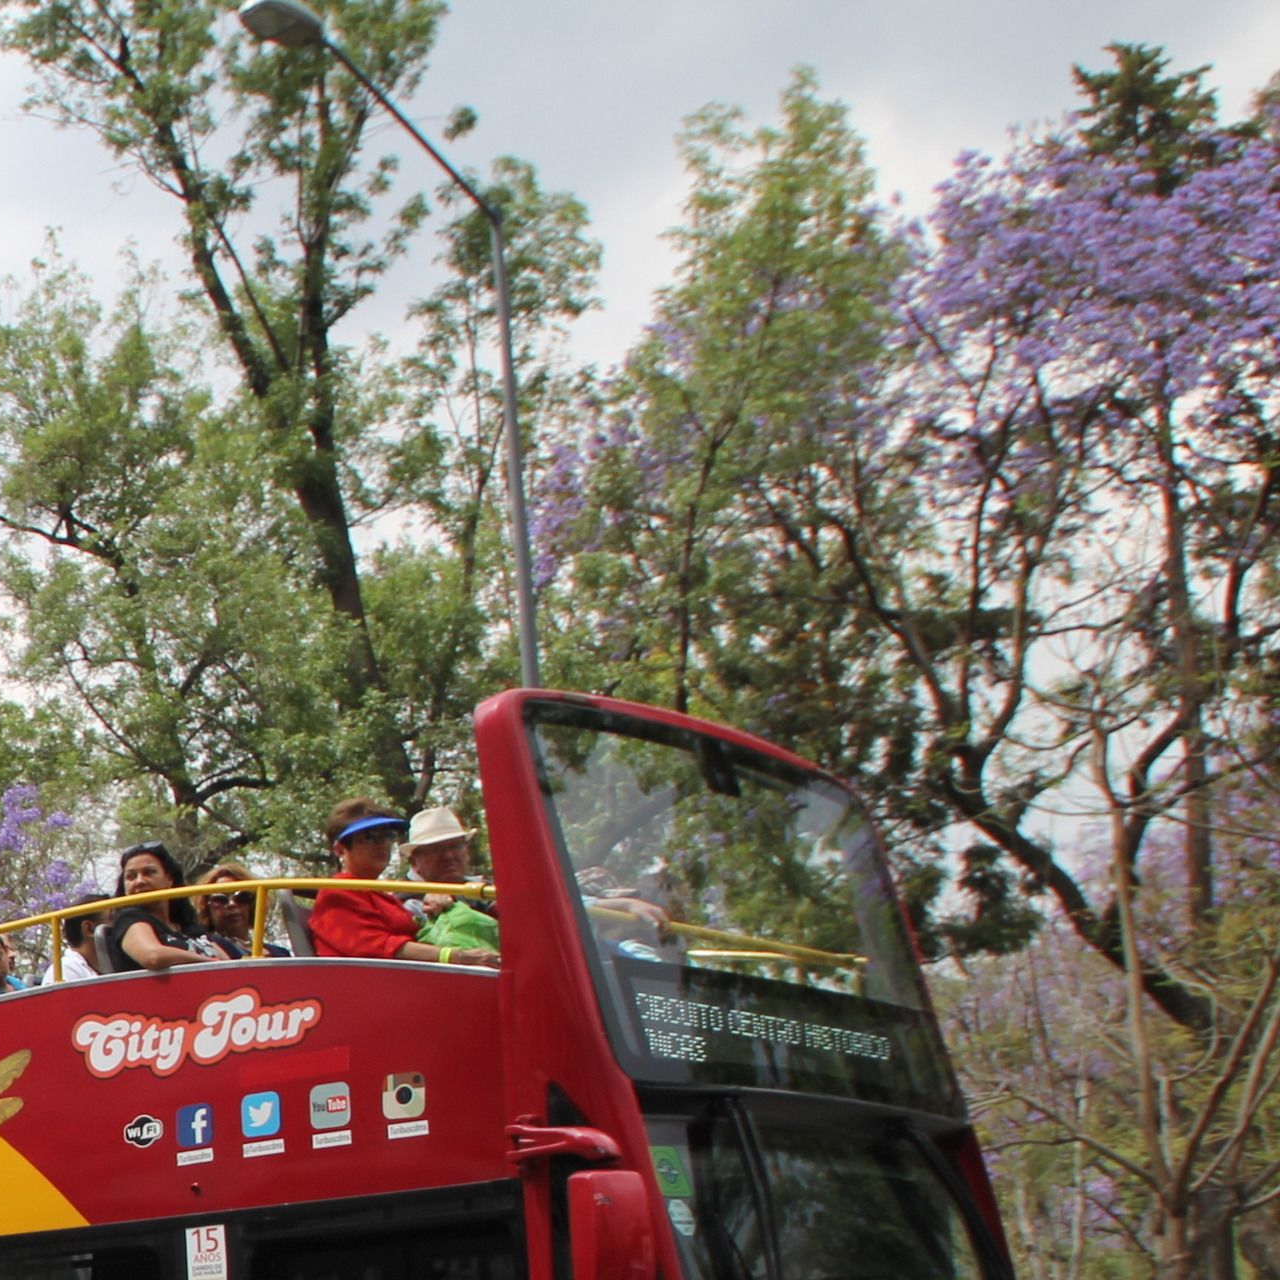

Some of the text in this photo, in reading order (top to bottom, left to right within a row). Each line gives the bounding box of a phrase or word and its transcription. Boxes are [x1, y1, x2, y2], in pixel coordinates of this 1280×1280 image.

[75, 994, 315, 1072] City Tour
[728, 1010, 800, 1044] CENTRO
[191, 1227, 219, 1253] 15
